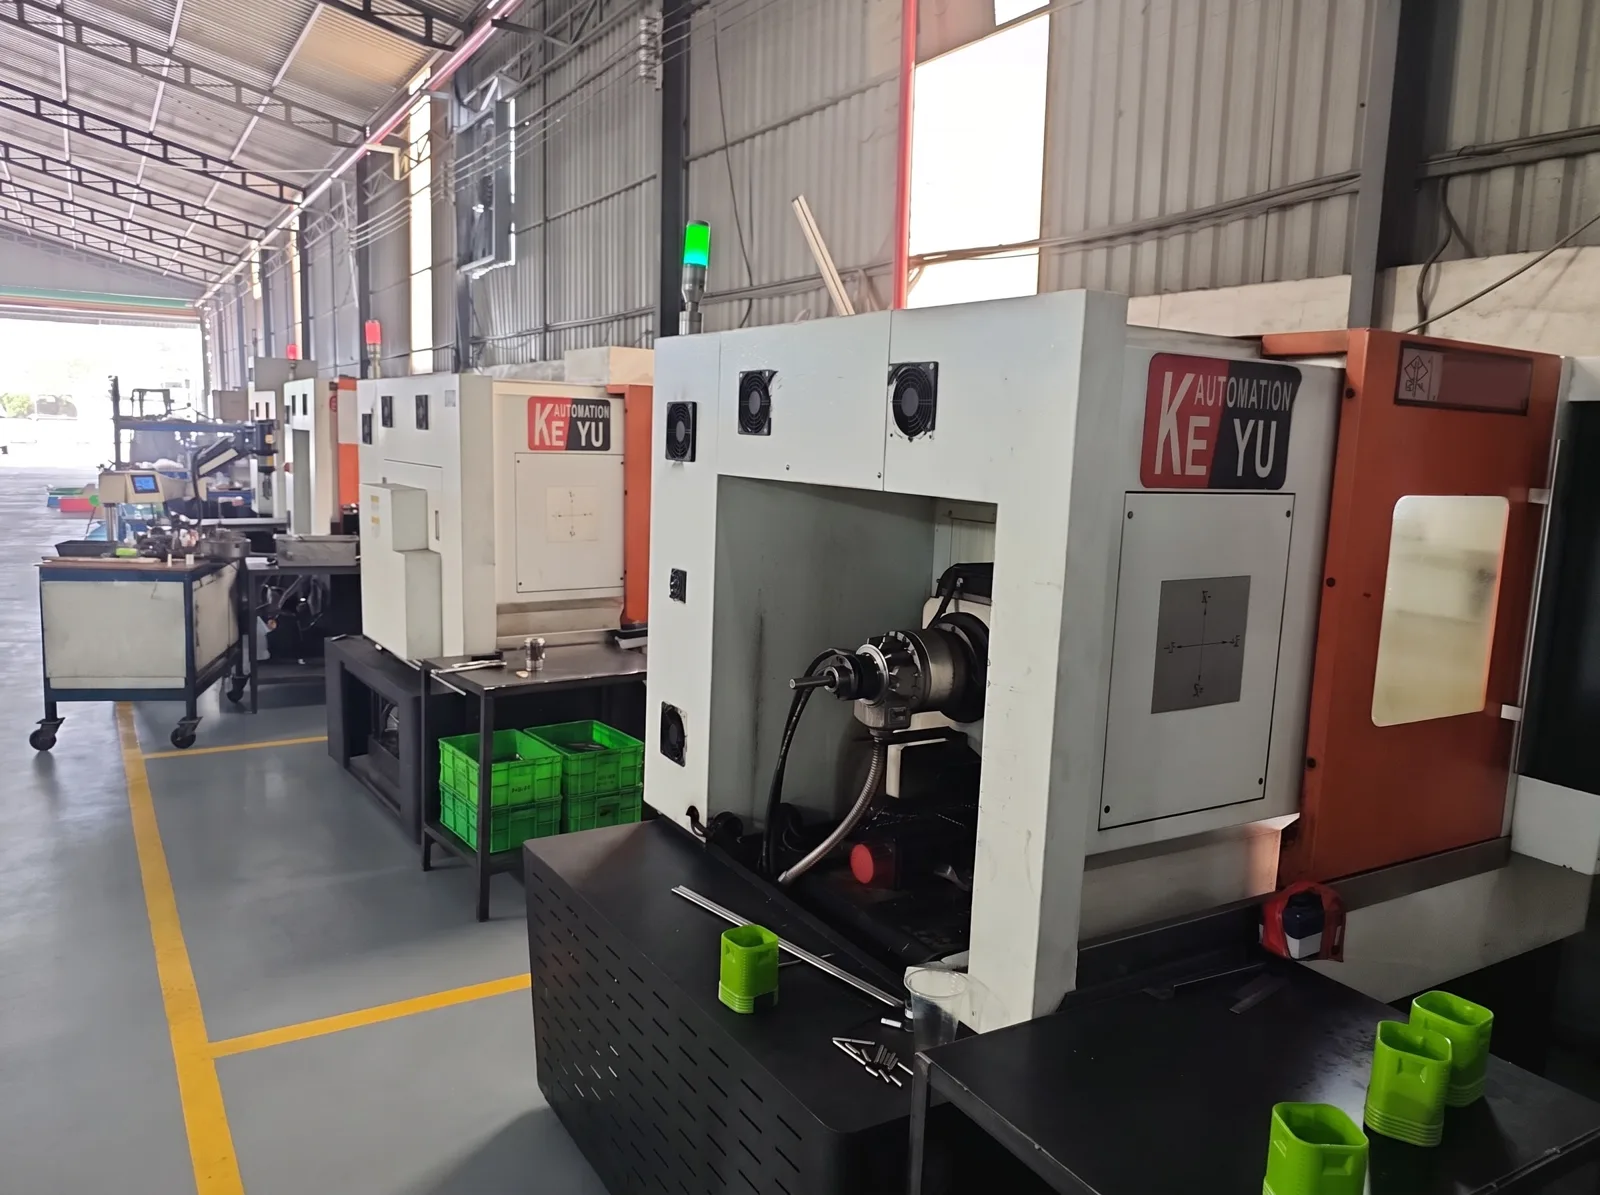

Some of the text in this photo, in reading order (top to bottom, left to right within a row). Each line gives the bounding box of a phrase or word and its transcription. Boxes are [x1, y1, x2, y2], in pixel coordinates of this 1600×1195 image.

[554, 404, 609, 418] AUTOMATION
[1194, 374, 1293, 412] AUTOMATION
[534, 403, 603, 447] KE YU
[1154, 371, 1277, 478] KE YU
